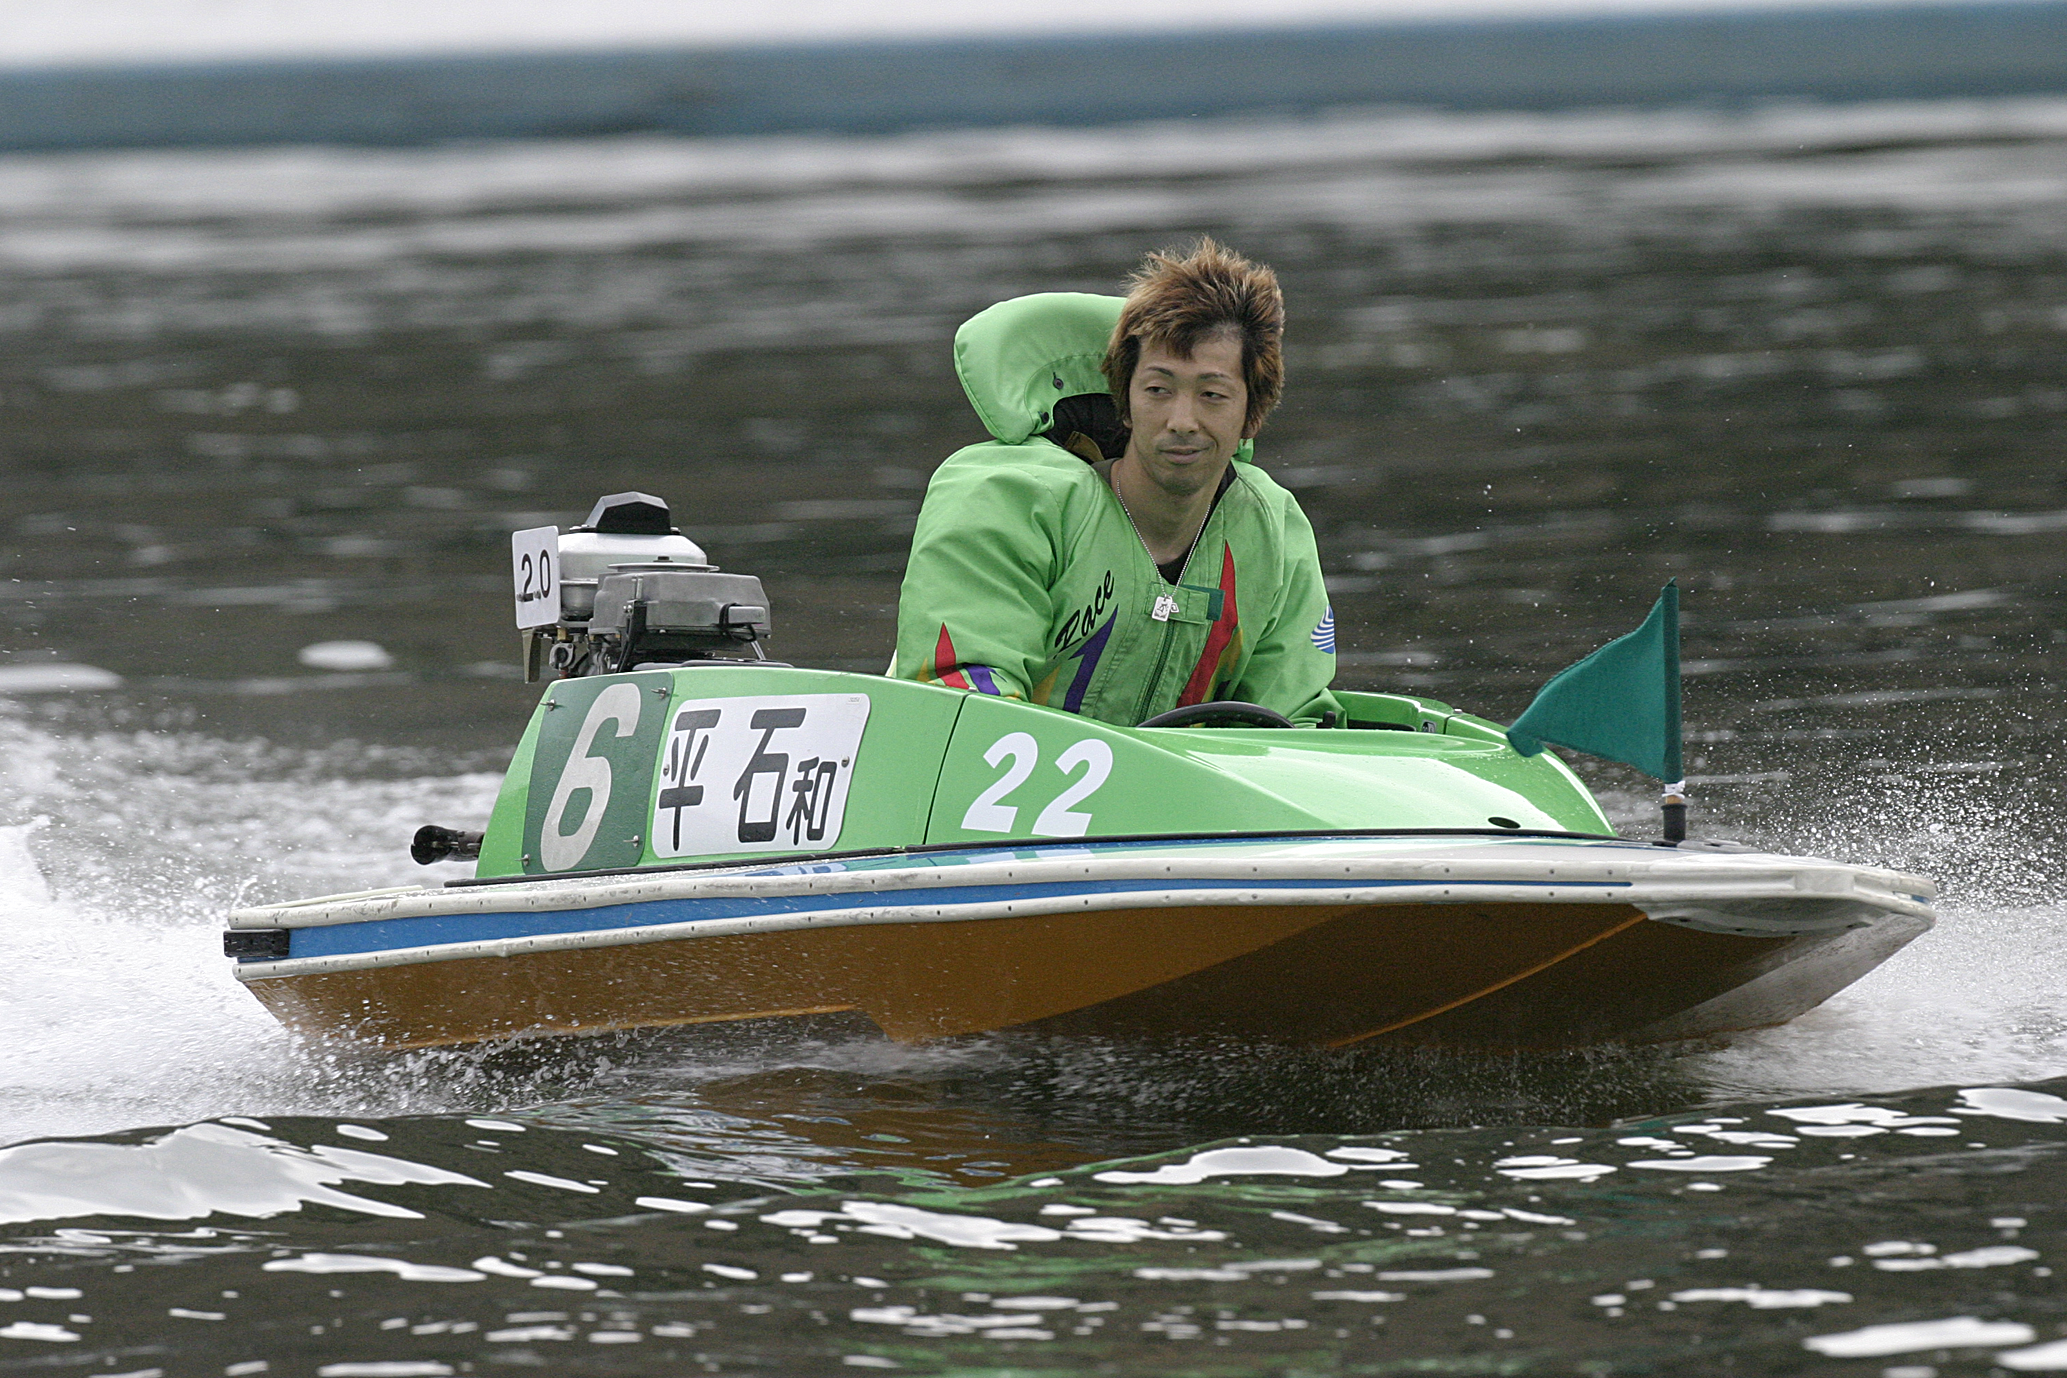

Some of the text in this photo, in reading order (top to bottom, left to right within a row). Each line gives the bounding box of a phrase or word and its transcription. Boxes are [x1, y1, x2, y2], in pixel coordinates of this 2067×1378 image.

[521, 549, 551, 602] 20
[1053, 570, 1115, 659] Race
[540, 683, 641, 872] 6
[659, 708, 837, 851] 平石和
[961, 732, 1114, 837] 22
